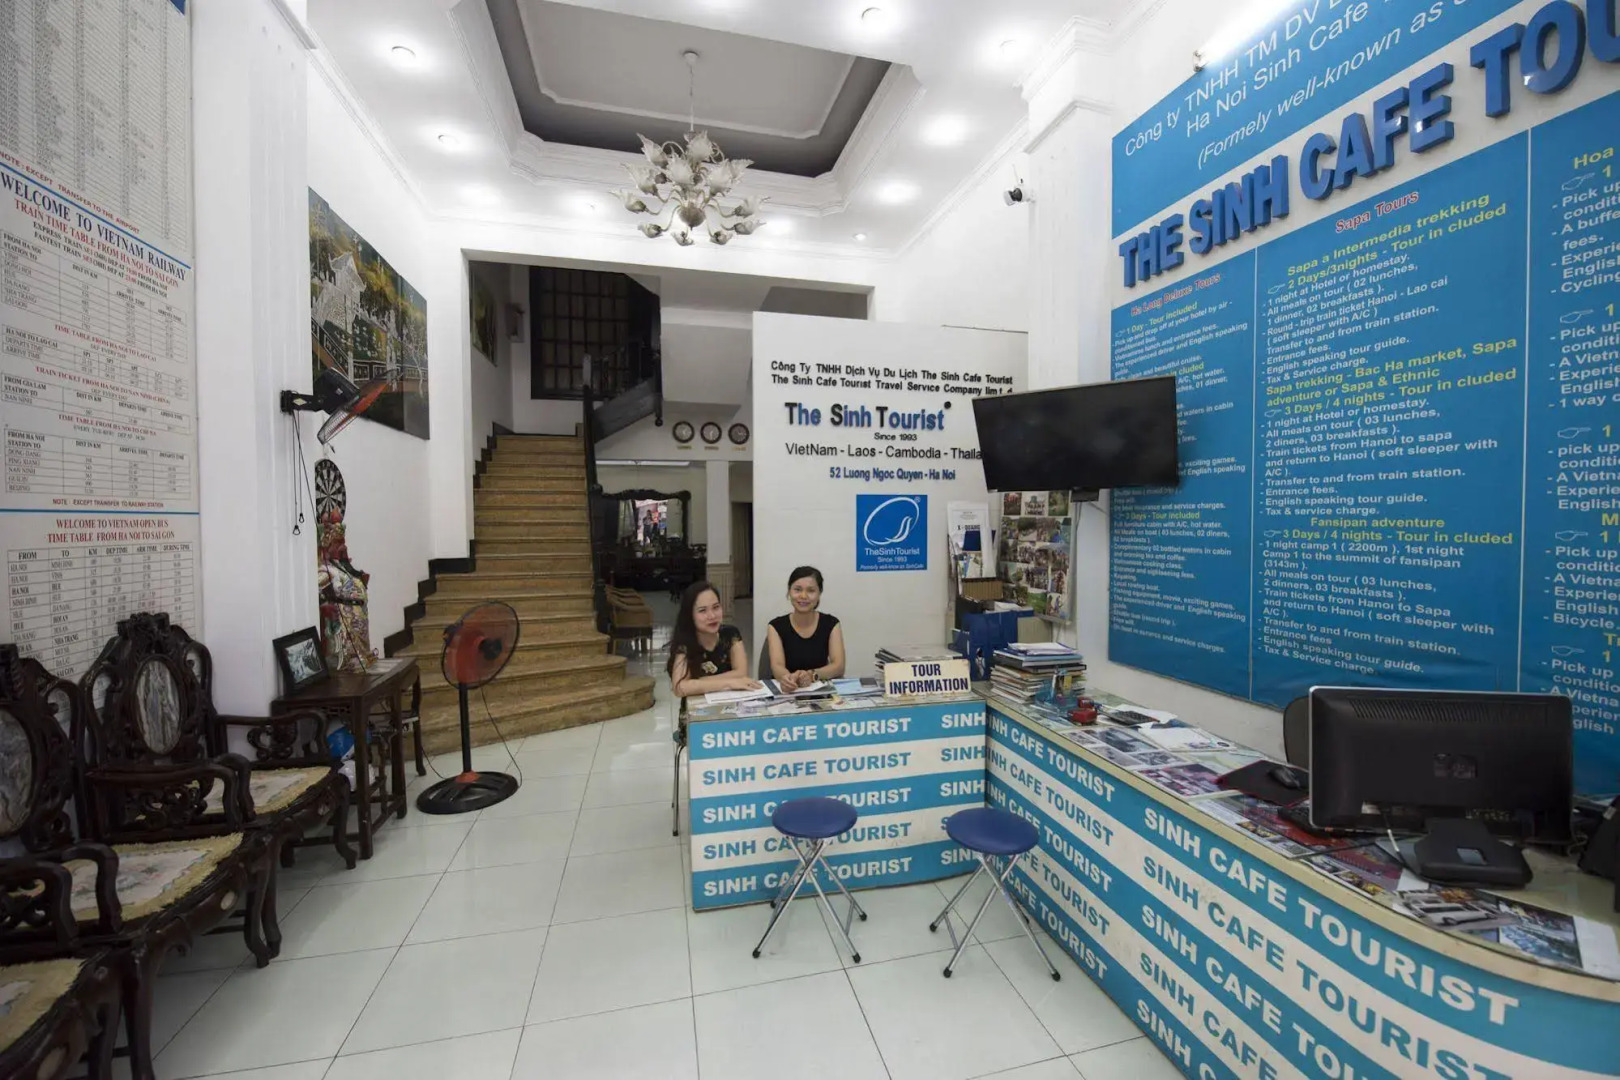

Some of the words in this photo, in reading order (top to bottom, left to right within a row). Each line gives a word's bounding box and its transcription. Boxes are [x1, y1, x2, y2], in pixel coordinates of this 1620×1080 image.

[1125, 121, 1162, 157] Công
[1167, 107, 1181, 129] ty
[1184, 60, 1239, 111] TNHH
[1245, 30, 1277, 67] TM
[1285, 0, 1320, 41] DV
[1187, 112, 1210, 137] Ha
[1216, 81, 1247, 118] Noi
[1254, 48, 1301, 91] Sinh
[1309, 1, 1369, 51] Cafe
[1198, 109, 1273, 170] (Formely
[1277, 28, 1401, 117] well-known
[1410, 1, 1443, 34] as
[1573, 147, 1614, 169] Hoa
[1119, 214, 1185, 288] THE
[1189, 154, 1290, 256] SINH
[1300, 62, 1455, 201] CAFE
[1562, 188, 1598, 207] Pick
[1335, 211, 1371, 234] Sapa
[1375, 191, 1420, 218] Tours
[1, 172, 71, 221] WELCOME
[76, 212, 92, 232] TO
[97, 224, 144, 259] VIETNAM
[148, 251, 186, 281] RAILWAY
[14, 199, 44, 221] TRAIN
[47, 215, 68, 234] TIME
[70, 227, 95, 246] TABLE
[97, 241, 120, 258] FROM
[120, 253, 131, 265] HA
[1287, 258, 1319, 277] Sapa
[1322, 254, 1330, 263] a
[1333, 224, 1412, 260] Intermedia
[1416, 193, 1490, 228] trekking
[1288, 280, 1294, 289] 2
[1391, 235, 1424, 254] Tour
[1429, 229, 1443, 239] in
[1448, 203, 1507, 233] cluded
[1563, 233, 1604, 251] fees.
[1560, 324, 1596, 341] Pick
[771, 360, 796, 373] Công
[799, 362, 811, 375] Ty
[816, 363, 842, 374] TNHH
[845, 365, 865, 377] Dịch
[868, 367, 880, 379] Vụ
[883, 368, 896, 378] Du
[899, 369, 918, 381] Lịch
[921, 370, 937, 380] The
[941, 371, 960, 381] Sinh
[963, 373, 982, 383] Cafe
[985, 374, 1013, 385] Tourist
[1266, 385, 1293, 396] Sapa
[1295, 372, 1344, 390] trekking
[1355, 365, 1381, 379] Bac
[1385, 360, 1403, 372] Ha
[1408, 347, 1467, 369] market,
[1472, 338, 1518, 355] Sapa
[771, 374, 789, 385] The
[792, 375, 813, 386] Sinh
[816, 376, 837, 387] Cafe
[840, 377, 871, 389] Tourist
[875, 380, 903, 391] Travel
[907, 381, 940, 392] Service
[943, 384, 982, 396] Company
[1266, 389, 1322, 407] adventure
[1324, 387, 1337, 396] or
[1341, 381, 1374, 394] Sapa
[1377, 376, 1388, 387] &
[1392, 366, 1441, 384] Ethnic
[784, 402, 822, 426] The
[830, 403, 872, 427] Sinh
[875, 406, 945, 431] Tourist
[874, 432, 897, 441] Since
[899, 433, 918, 441] 1993
[785, 442, 838, 456] VietNam
[848, 444, 876, 457] Laos
[885, 445, 941, 459] Cambodia
[1558, 444, 1593, 457] pick
[829, 467, 841, 479] 52
[843, 467, 871, 481] Luong
[873, 468, 895, 482] Ngoc
[942, 469, 956, 480] Noi
[56, 519, 95, 529] WELCOME
[98, 519, 107, 528] TO
[109, 519, 139, 528] VIETNAM
[1310, 517, 1367, 529] Fansipan
[1371, 518, 1445, 528] adventure
[47, 533, 68, 543] TIME
[70, 532, 93, 542] TABLE
[97, 532, 118, 541] FROM
[1283, 530, 1290, 539] 3
[1292, 529, 1322, 541] Days
[1330, 530, 1338, 539] 4
[1341, 530, 1383, 542] nights
[1396, 530, 1430, 543] Tour
[1434, 532, 1449, 543] in
[1454, 532, 1514, 545] cluded
[864, 547, 920, 556] TheSinhTourist
[1555, 546, 1590, 557] Pick
[1596, 549, 1618, 560] up
[1555, 600, 1619, 616] English
[911, 664, 941, 676] TOUR
[1551, 659, 1587, 674] Pick
[1592, 667, 1615, 679] up
[889, 678, 968, 694] INFORMATION
[702, 730, 756, 749] SINH
[762, 725, 818, 744] CAFE
[824, 717, 911, 739] TOURIST
[941, 712, 986, 729] SINH
[940, 745, 986, 763] SINH
[1011, 728, 1044, 759] CAFE
[1048, 747, 1116, 802] TOURIST
[703, 767, 756, 785] SINH
[763, 761, 818, 780] CAFE
[824, 752, 911, 774] TOURIST
[940, 780, 985, 797] SINH
[703, 804, 756, 824] SINH
[1010, 763, 1042, 796] CAFE
[1046, 787, 1114, 847] TOURIST
[703, 840, 756, 860] SINH
[1044, 825, 1112, 893] TOURIST
[704, 875, 757, 897] SINH
[824, 857, 913, 880] TOURIST
[1042, 865, 1110, 936] TOURIST
[1143, 856, 1199, 911] SINH
[1208, 901, 1285, 972] CAFE
[1144, 807, 1201, 857] SINH
[1209, 847, 1288, 912] CAFE
[1298, 899, 1520, 1026] TOURIST
[1040, 901, 1108, 980] TOURIST
[1141, 905, 1198, 966] SINH
[1205, 957, 1282, 1035] CAFE
[1139, 952, 1195, 1016] SINH
[1203, 1008, 1277, 1080] CAFE
[1136, 999, 1192, 1068] SINH
